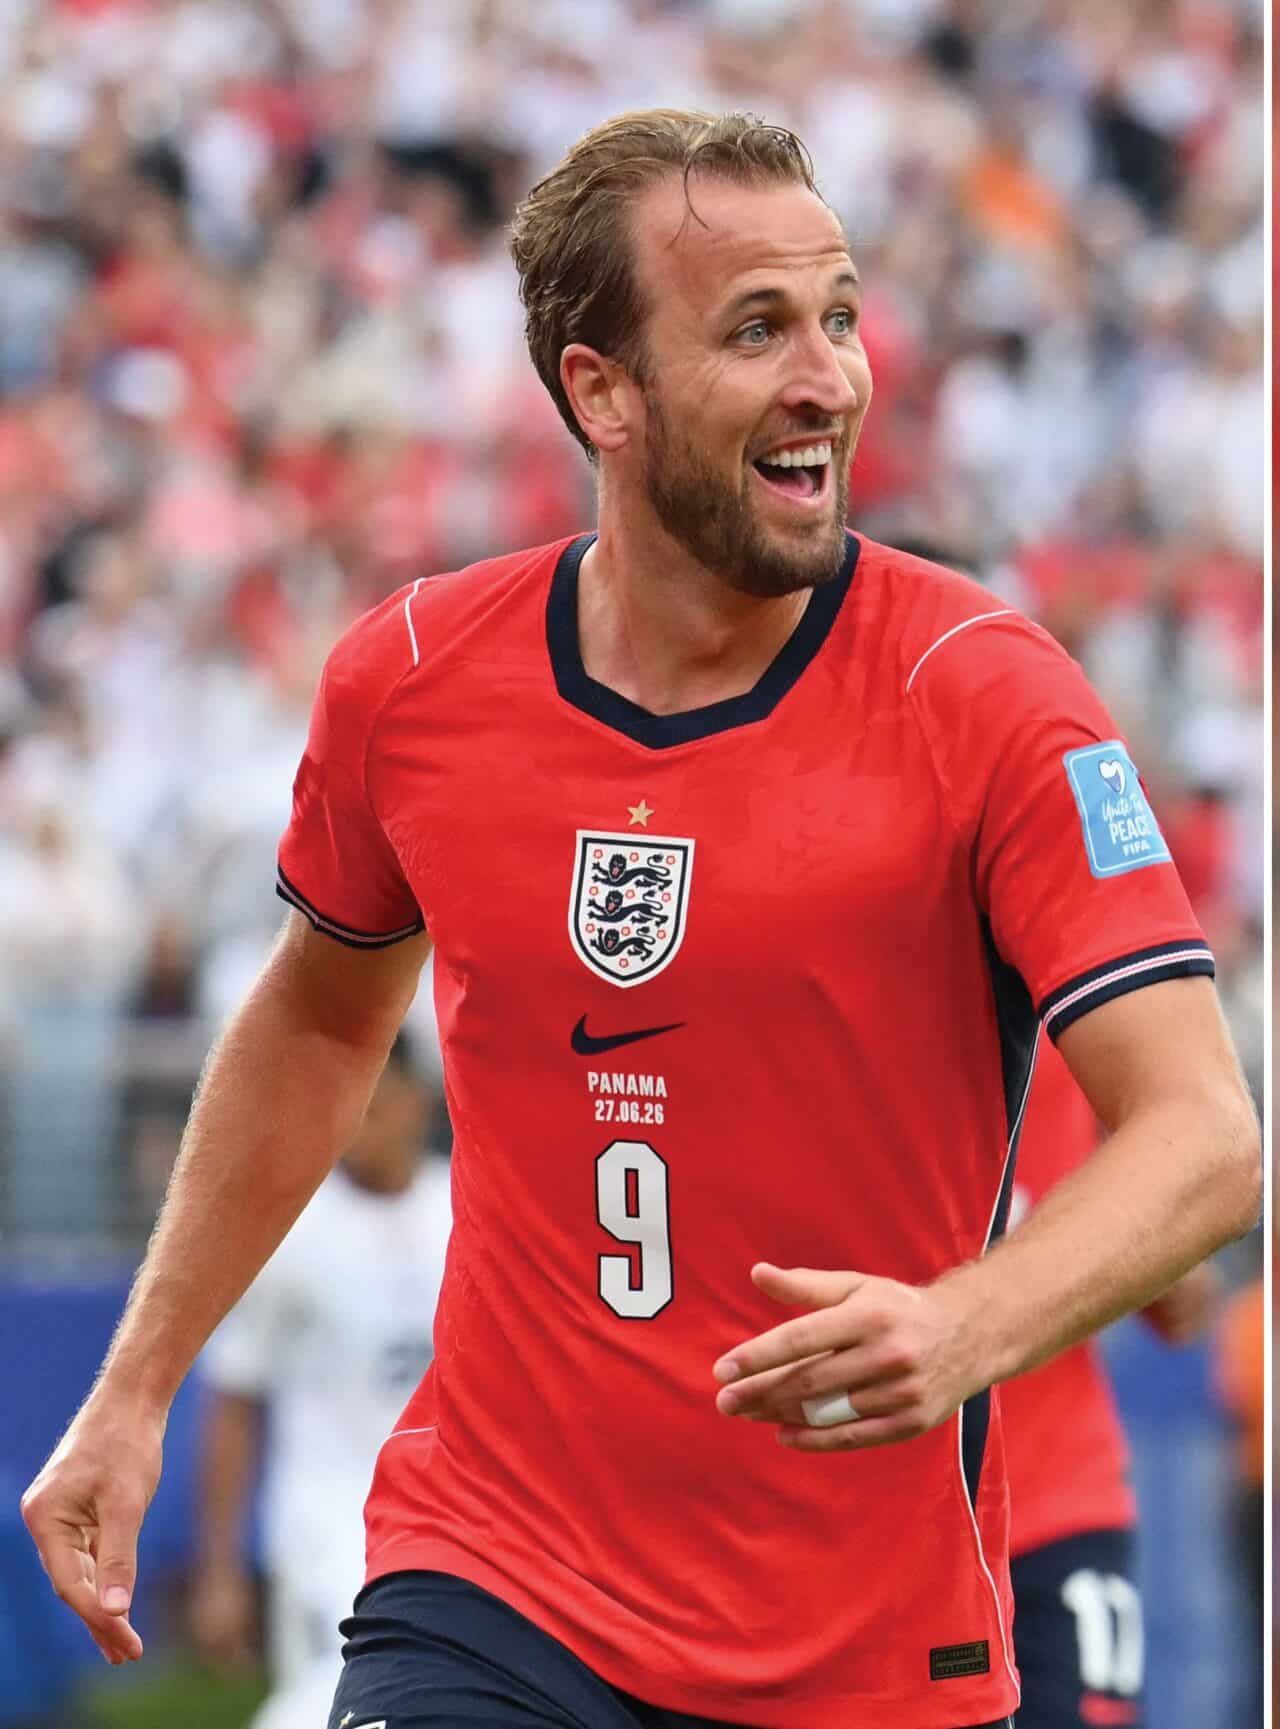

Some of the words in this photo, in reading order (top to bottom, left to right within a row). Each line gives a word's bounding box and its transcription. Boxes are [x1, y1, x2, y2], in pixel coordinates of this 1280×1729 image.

[588, 1071, 667, 1098] PANAMA
[595, 1099, 664, 1125] 27.06.26
[595, 1139, 674, 1320] 9
